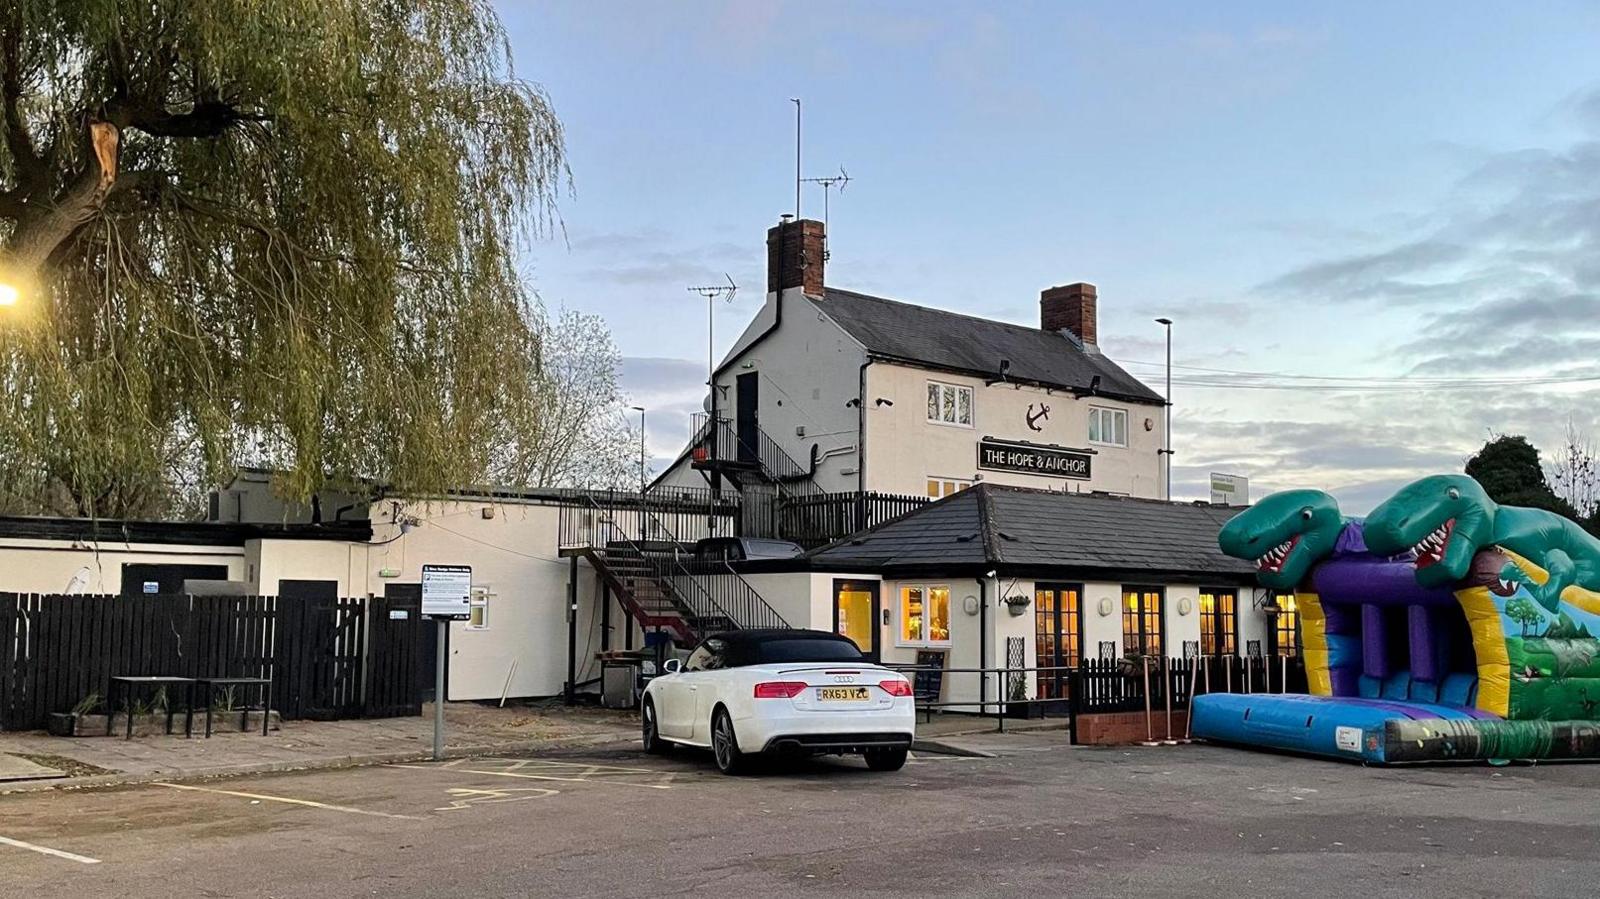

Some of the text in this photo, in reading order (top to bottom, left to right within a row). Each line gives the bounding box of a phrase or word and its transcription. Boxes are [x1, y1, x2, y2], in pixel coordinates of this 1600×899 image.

[985, 450, 1086, 473] THE HOPE & ANCHOR
[822, 689, 848, 698] RX63
